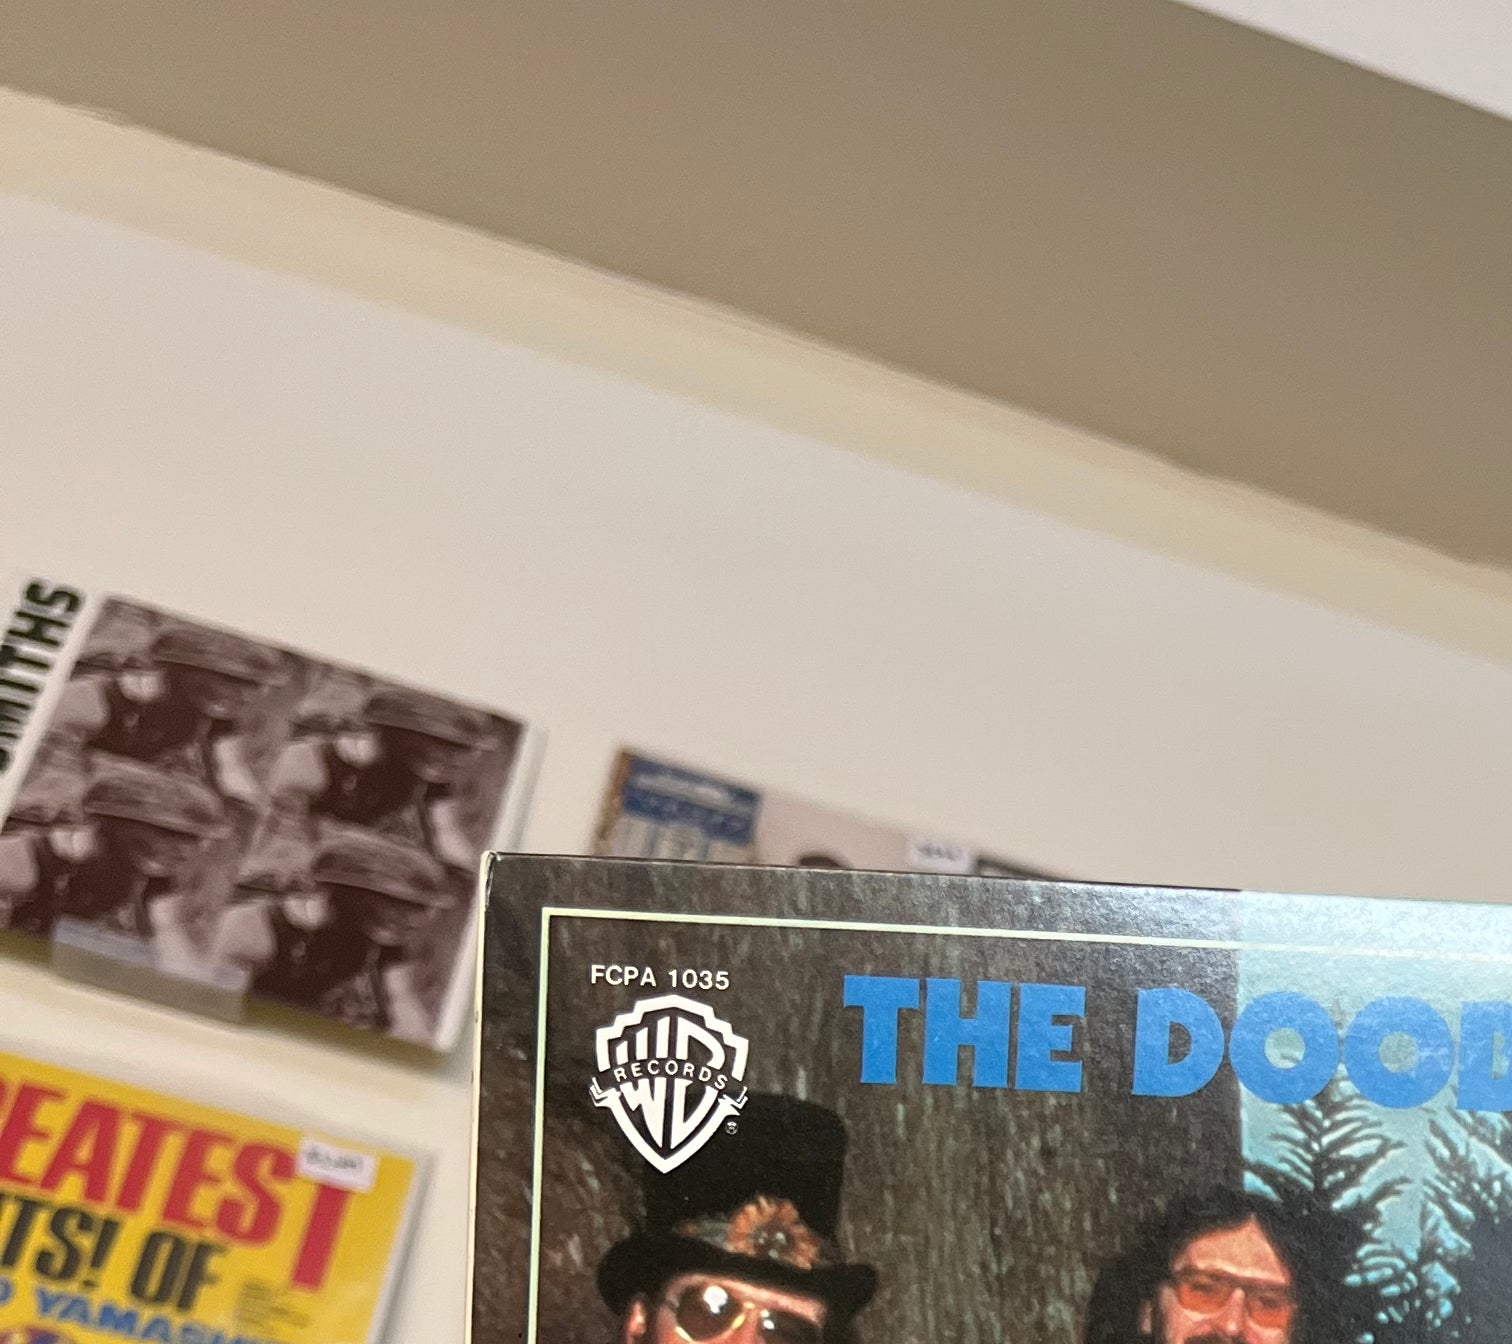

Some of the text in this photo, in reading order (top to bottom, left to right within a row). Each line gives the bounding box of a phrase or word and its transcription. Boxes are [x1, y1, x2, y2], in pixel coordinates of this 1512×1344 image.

[590, 963, 731, 991] FCPA 1035
[613, 1059, 729, 1090] RECORDS
[844, 976, 1084, 1092] THE
[0, 1068, 350, 1292] EATEST
[130, 1229, 230, 1314] OF
